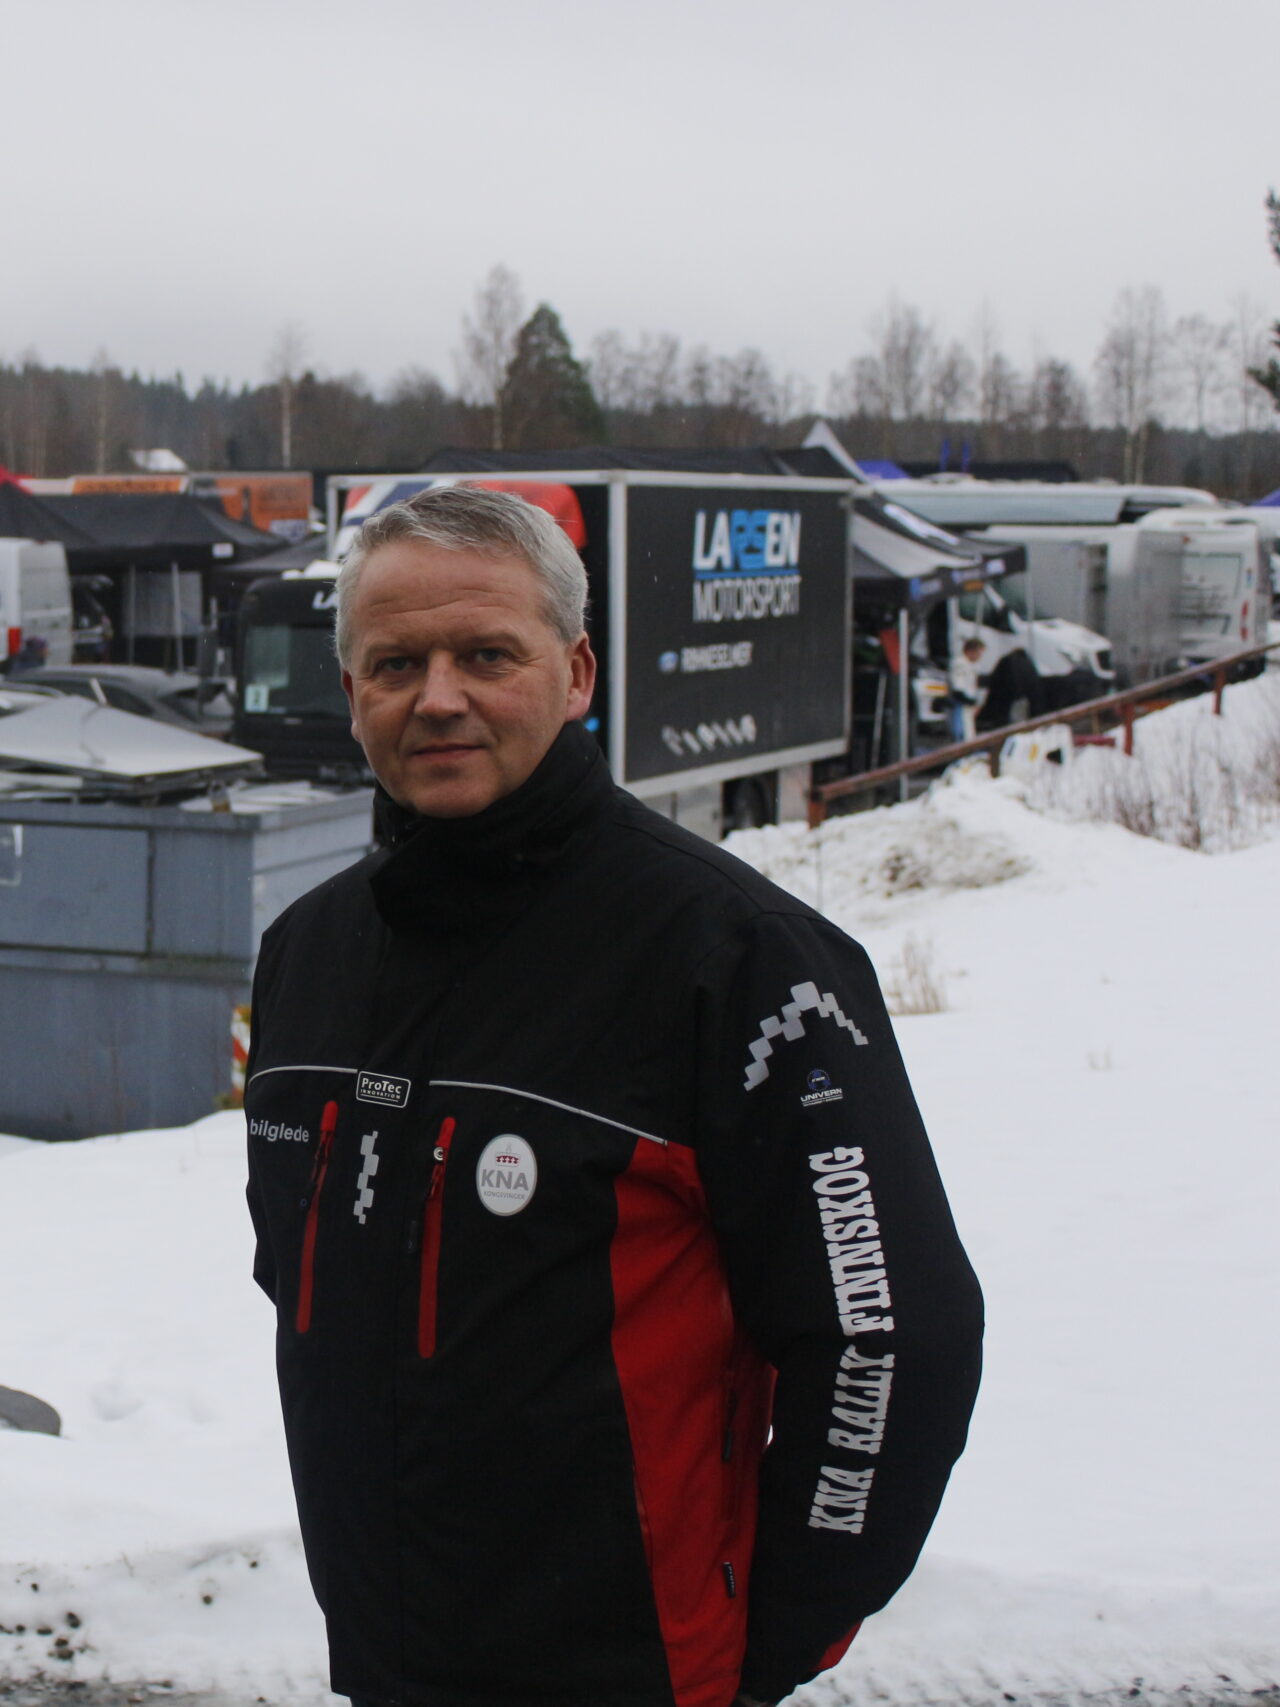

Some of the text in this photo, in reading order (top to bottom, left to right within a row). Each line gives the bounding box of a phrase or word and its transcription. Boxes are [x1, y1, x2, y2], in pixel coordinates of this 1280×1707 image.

[693, 575, 801, 622] MOTORSPORT
[360, 1088, 401, 1099] INNOVATION
[361, 1077, 402, 1094] ProTec
[249, 1118, 309, 1142] bilglede
[481, 1168, 529, 1191] KNA
[808, 1146, 895, 1337] FINNSKOG
[827, 1344, 895, 1454] RALLY
[808, 1465, 875, 1534] KNA
